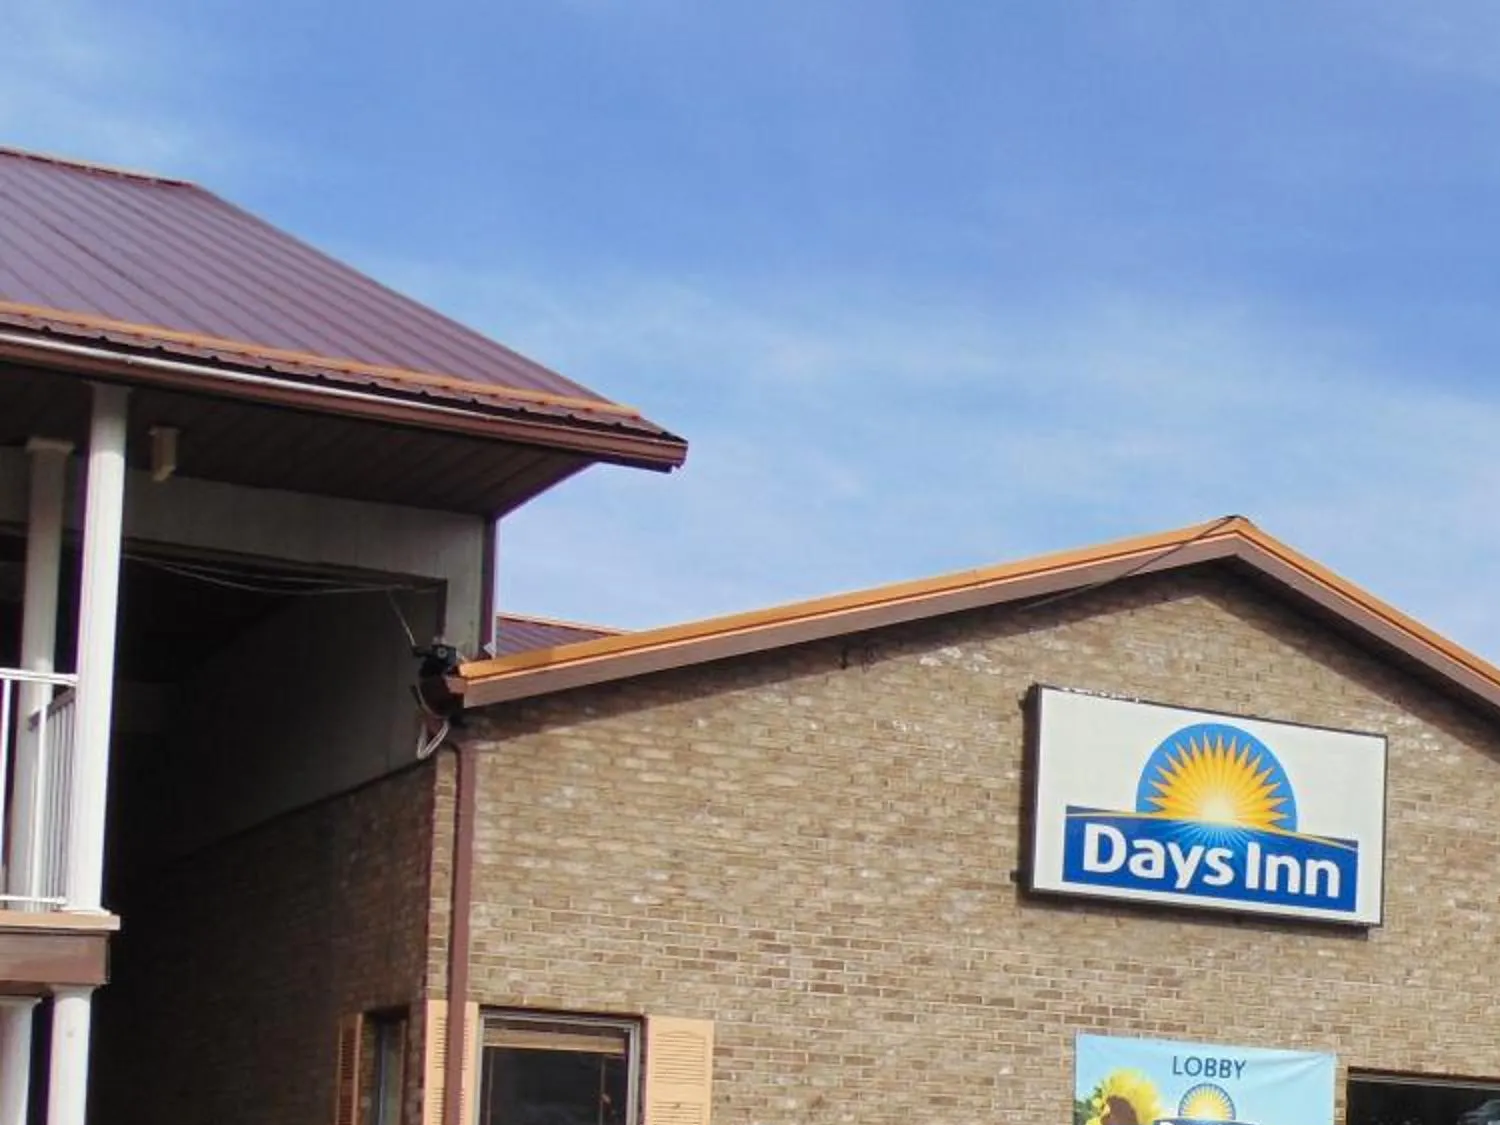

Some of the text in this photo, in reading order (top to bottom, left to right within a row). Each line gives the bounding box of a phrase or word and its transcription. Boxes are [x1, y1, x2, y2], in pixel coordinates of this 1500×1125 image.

[1083, 823, 1340, 898] Days Inn
[1173, 1055, 1247, 1080] LOBBY
